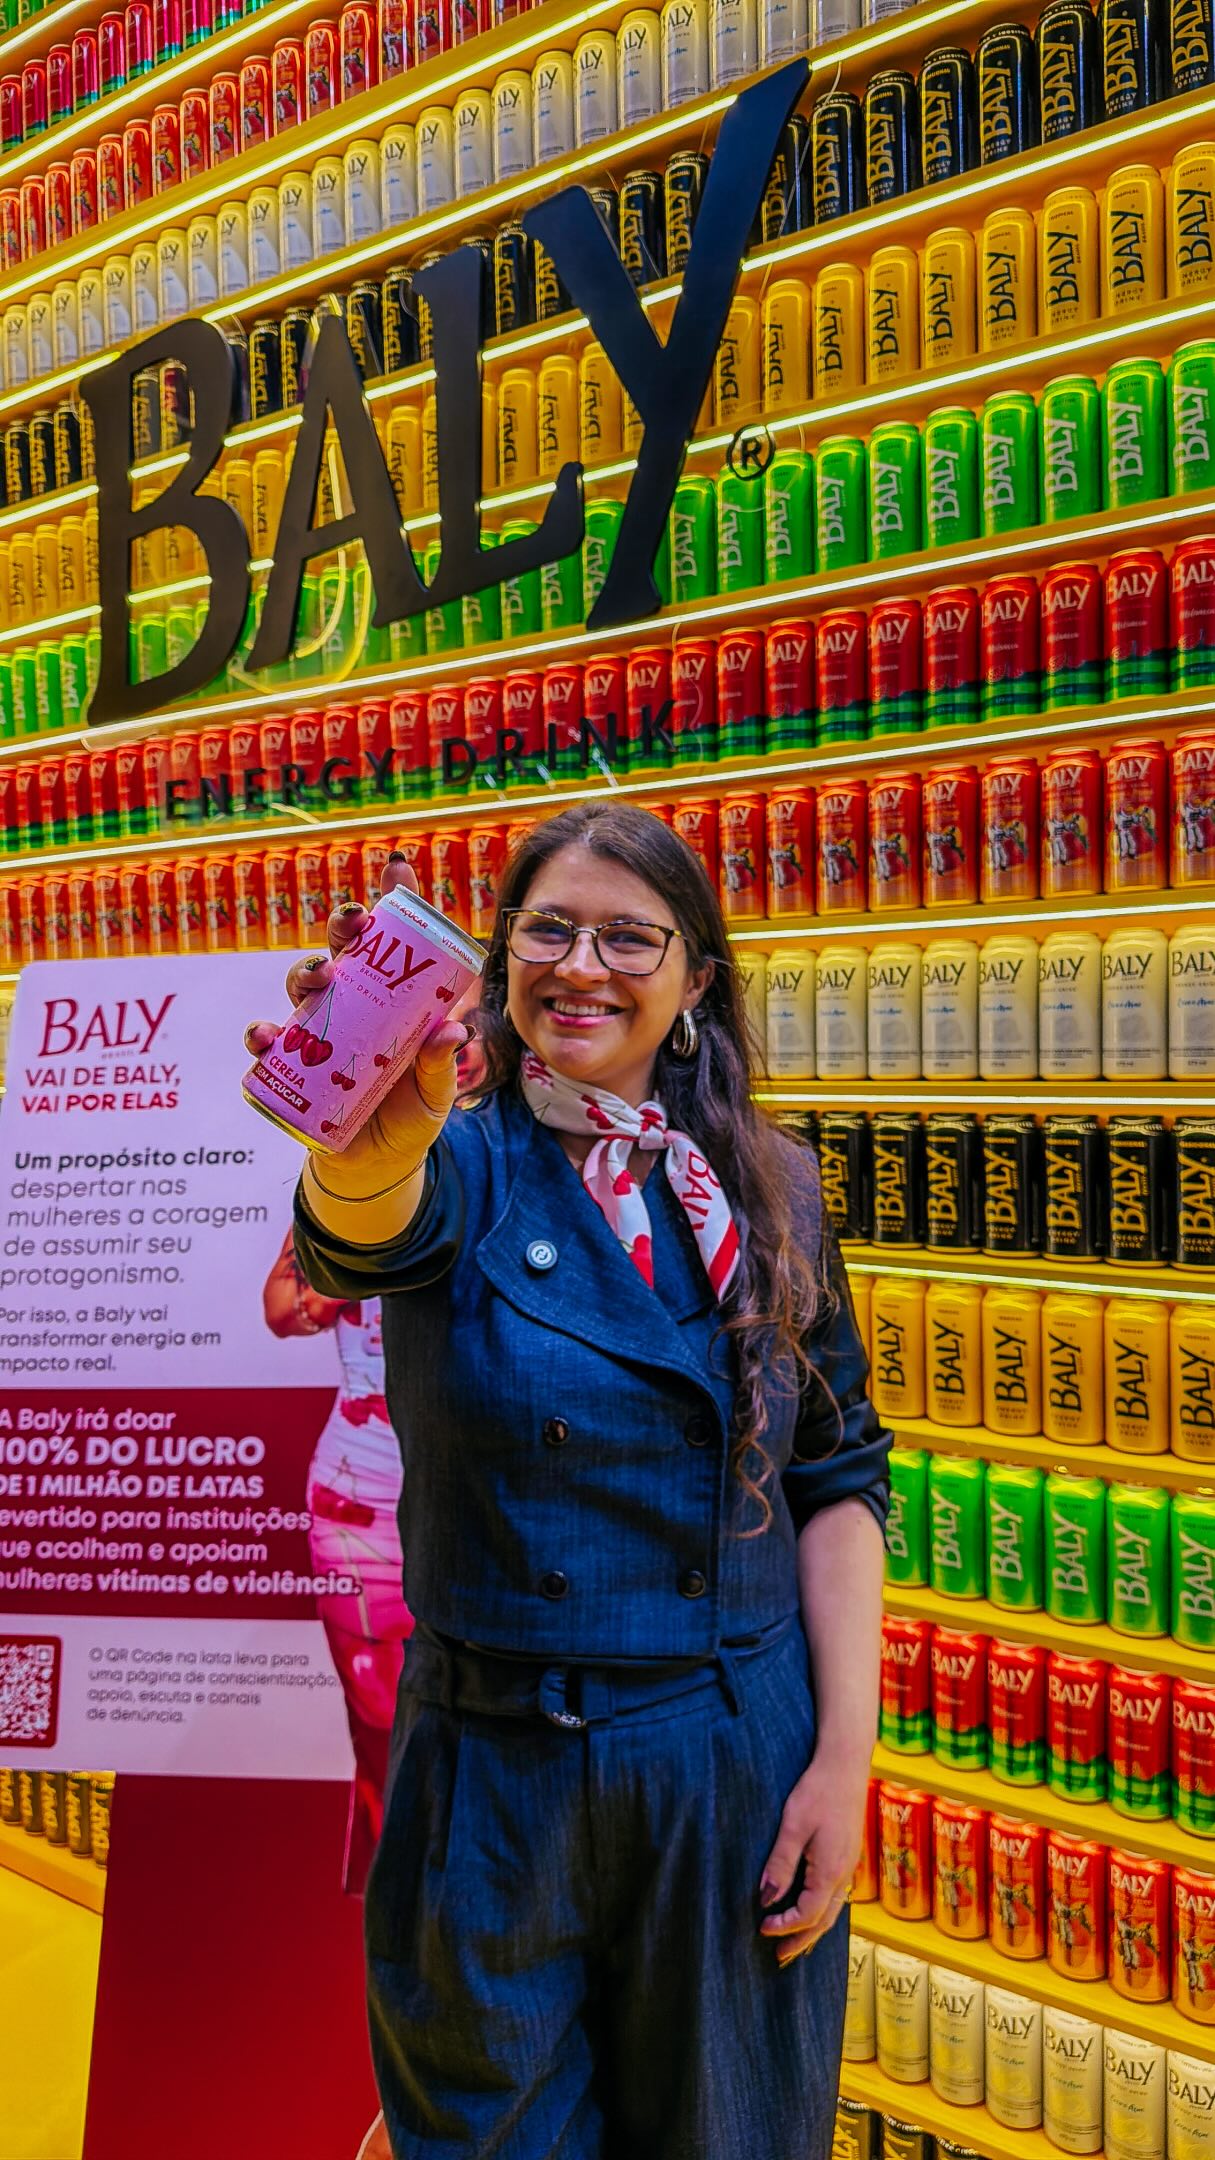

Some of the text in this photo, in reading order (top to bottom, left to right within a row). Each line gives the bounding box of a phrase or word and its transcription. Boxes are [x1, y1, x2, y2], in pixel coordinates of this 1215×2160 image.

[666, 2, 696, 28] ALY
[622, 26, 647, 50] ALY
[579, 47, 604, 71] ALY
[1104, 18, 1138, 101] BALY
[538, 67, 559, 91] ALY
[1042, 42, 1075, 131] BALY
[925, 90, 953, 160] BALY
[981, 67, 1013, 144] BALY
[817, 134, 841, 199] BALY
[869, 113, 894, 191] BALY
[1177, 189, 1212, 268] BALY
[1110, 210, 1146, 288] BALY
[986, 251, 1017, 325] BALY
[1047, 231, 1080, 308] BALY
[871, 289, 900, 360] BALY
[924, 271, 953, 343] BALY
[80, 57, 811, 727] BALY
[1108, 401, 1144, 482] BALY
[1174, 385, 1211, 468] BALY
[983, 433, 1016, 510] BALY
[1045, 417, 1078, 496] BALY
[872, 463, 904, 535] BALY
[927, 448, 960, 522] BALY
[165, 699, 677, 821] ENERGY DRINK
[441, 935, 474, 965] VITAMINAS
[1040, 955, 1086, 983] BALY
[1102, 952, 1154, 981] BALY
[359, 967, 384, 985] BRASIL
[816, 967, 857, 992] BALY
[868, 964, 913, 990] BALY
[922, 961, 967, 987] BALY
[979, 958, 1024, 985] BALY
[356, 984, 387, 1009] DRINK
[38, 993, 178, 1058] BALY
[25, 1063, 182, 1089] VAI DE BALY,
[255, 1064, 304, 1108] SEM AÇÚCAR
[269, 1055, 306, 1090] CEREJA
[22, 1091, 179, 1114] VAI POR ELAS
[15, 1148, 255, 1173] Um propósito claro:
[10, 1178, 188, 1202] despertar nas
[873, 1145, 906, 1218] BALY
[926, 1145, 958, 1223] BALY
[984, 1147, 1018, 1226] BALY
[1045, 1149, 1081, 1230] BALY
[1109, 1151, 1148, 1235] BALY
[1178, 1152, 1215, 1237] BALY
[7, 1206, 269, 1229] mulheres a coragem
[3, 1233, 193, 1258] de assumir seu
[0, 1262, 185, 1291] protagonismo.
[30, 1305, 71, 1325] isso,
[76, 1309, 89, 1324] a
[94, 1305, 135, 1327] Baly
[139, 1304, 169, 1323] vai
[0, 1329, 222, 1350] ransformar energia em
[876, 1312, 906, 1388] BALY
[932, 1318, 965, 1396] BALY
[74, 1355, 117, 1372] real.
[993, 1325, 1029, 1405] BALY
[1047, 1331, 1082, 1413] BALY
[1113, 1337, 1150, 1421] BALY
[1179, 1345, 1215, 1430] BALY
[0, 1406, 177, 1435] A Baly irá doar
[85, 1436, 139, 1467] DO
[145, 1436, 266, 1467] LUCRO
[26, 1475, 37, 1497] 1
[40, 1469, 143, 1498] MILHÃO
[147, 1475, 181, 1499] DE
[184, 1475, 265, 1499] LATAS
[0, 1505, 313, 1537] evertido para instituições
[931, 1487, 963, 1571] BALY
[989, 1497, 1024, 1583] BALY
[0, 1536, 268, 1567] ue acolhem e apoiam
[1052, 1509, 1089, 1595] BALY
[1113, 1520, 1151, 1606] BALY
[97, 1567, 192, 1594] vítimas
[194, 1569, 229, 1595] de
[233, 1569, 363, 1596] violência.
[1179, 1529, 1215, 1620] BALY
[88, 1648, 310, 1668] O QR Code na lata leva para
[88, 1670, 123, 1683] uma
[126, 1668, 181, 1686] página
[185, 1669, 205, 1685] de
[931, 1647, 977, 1681] BALY
[987, 1659, 1034, 1695] BALY
[87, 1688, 262, 1705] apoio, escuta e canais
[1048, 1673, 1100, 1710] BALY
[1109, 1687, 1163, 1726] BALY
[86, 1708, 107, 1722] de
[1048, 1844, 1089, 1878] BALY
[1110, 1864, 1154, 1898] BALY
[986, 2002, 1036, 2041] BALY
[1045, 2023, 1095, 2063] BALY
[1105, 2045, 1156, 2087] BALY
